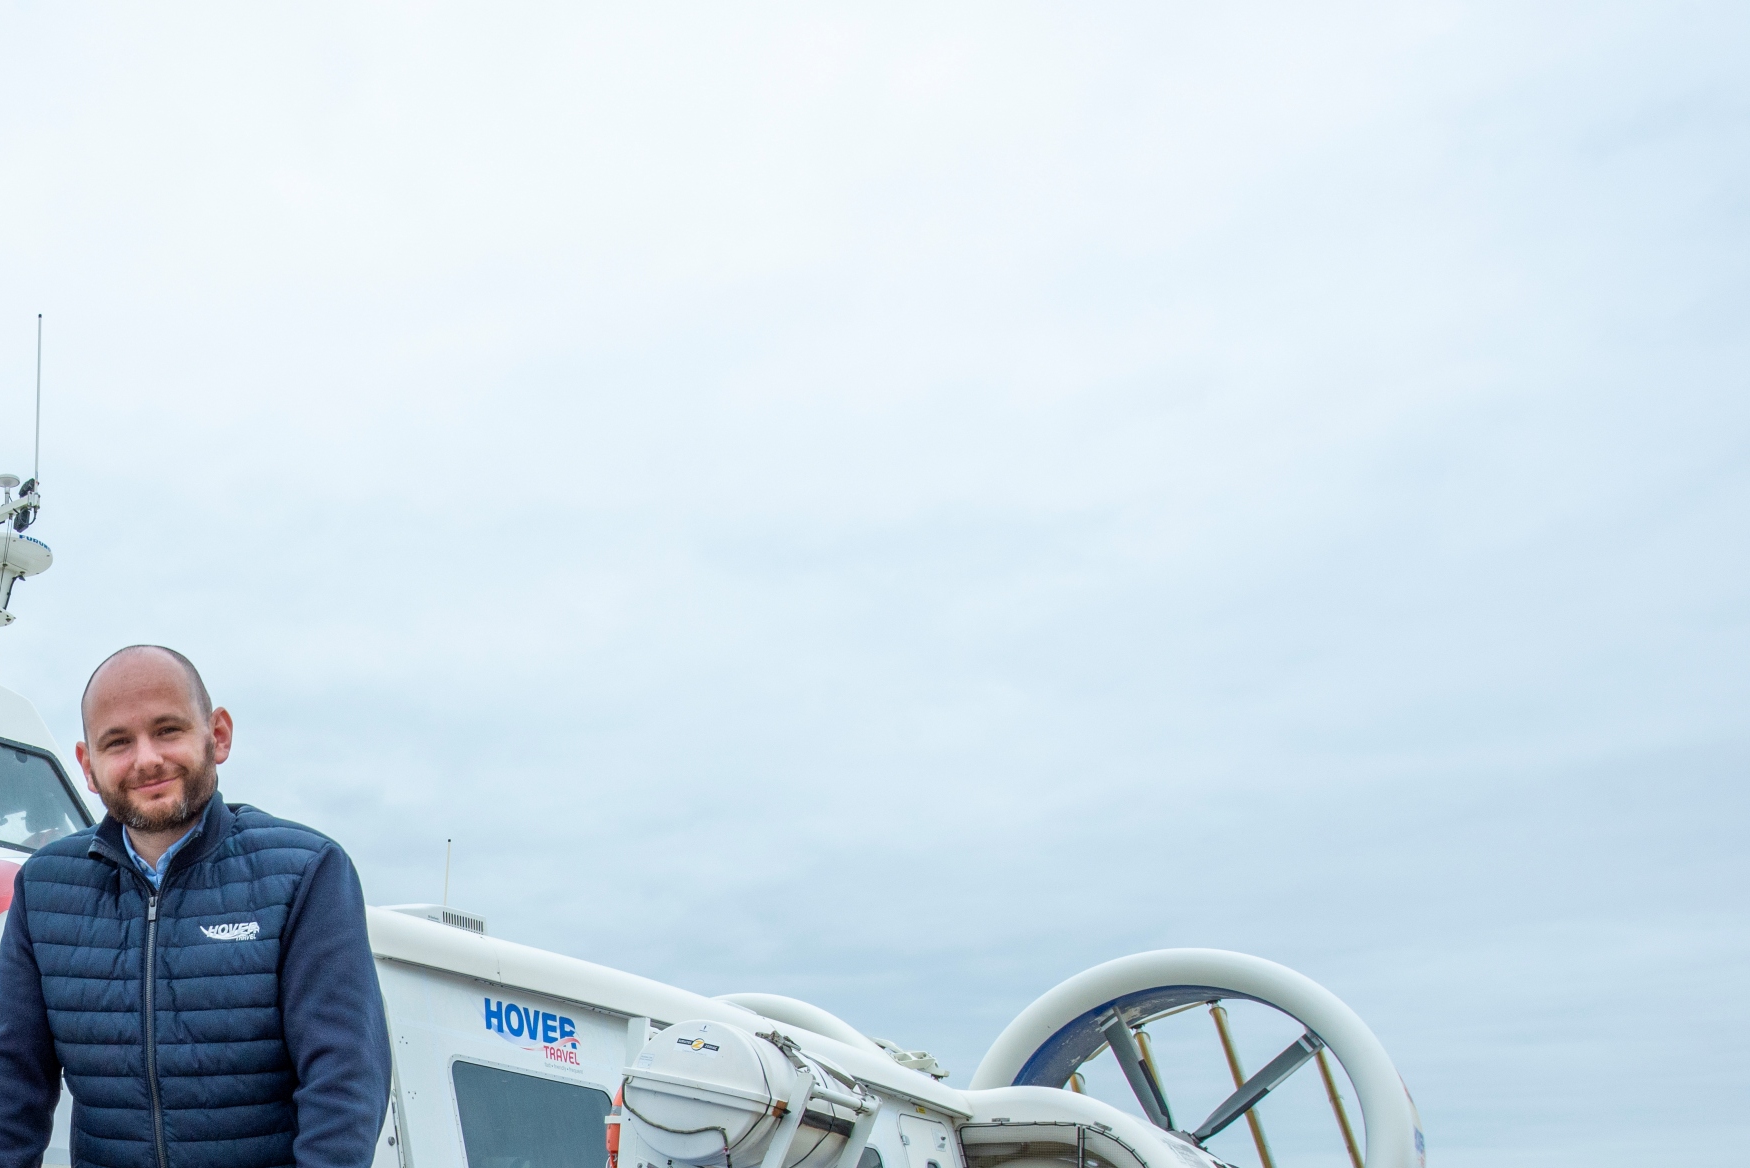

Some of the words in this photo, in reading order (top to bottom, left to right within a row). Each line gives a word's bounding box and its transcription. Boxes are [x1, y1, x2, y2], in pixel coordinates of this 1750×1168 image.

[207, 922, 260, 937] HOVER
[484, 997, 578, 1050] HOVER
[543, 1045, 581, 1066] TRAVEL
